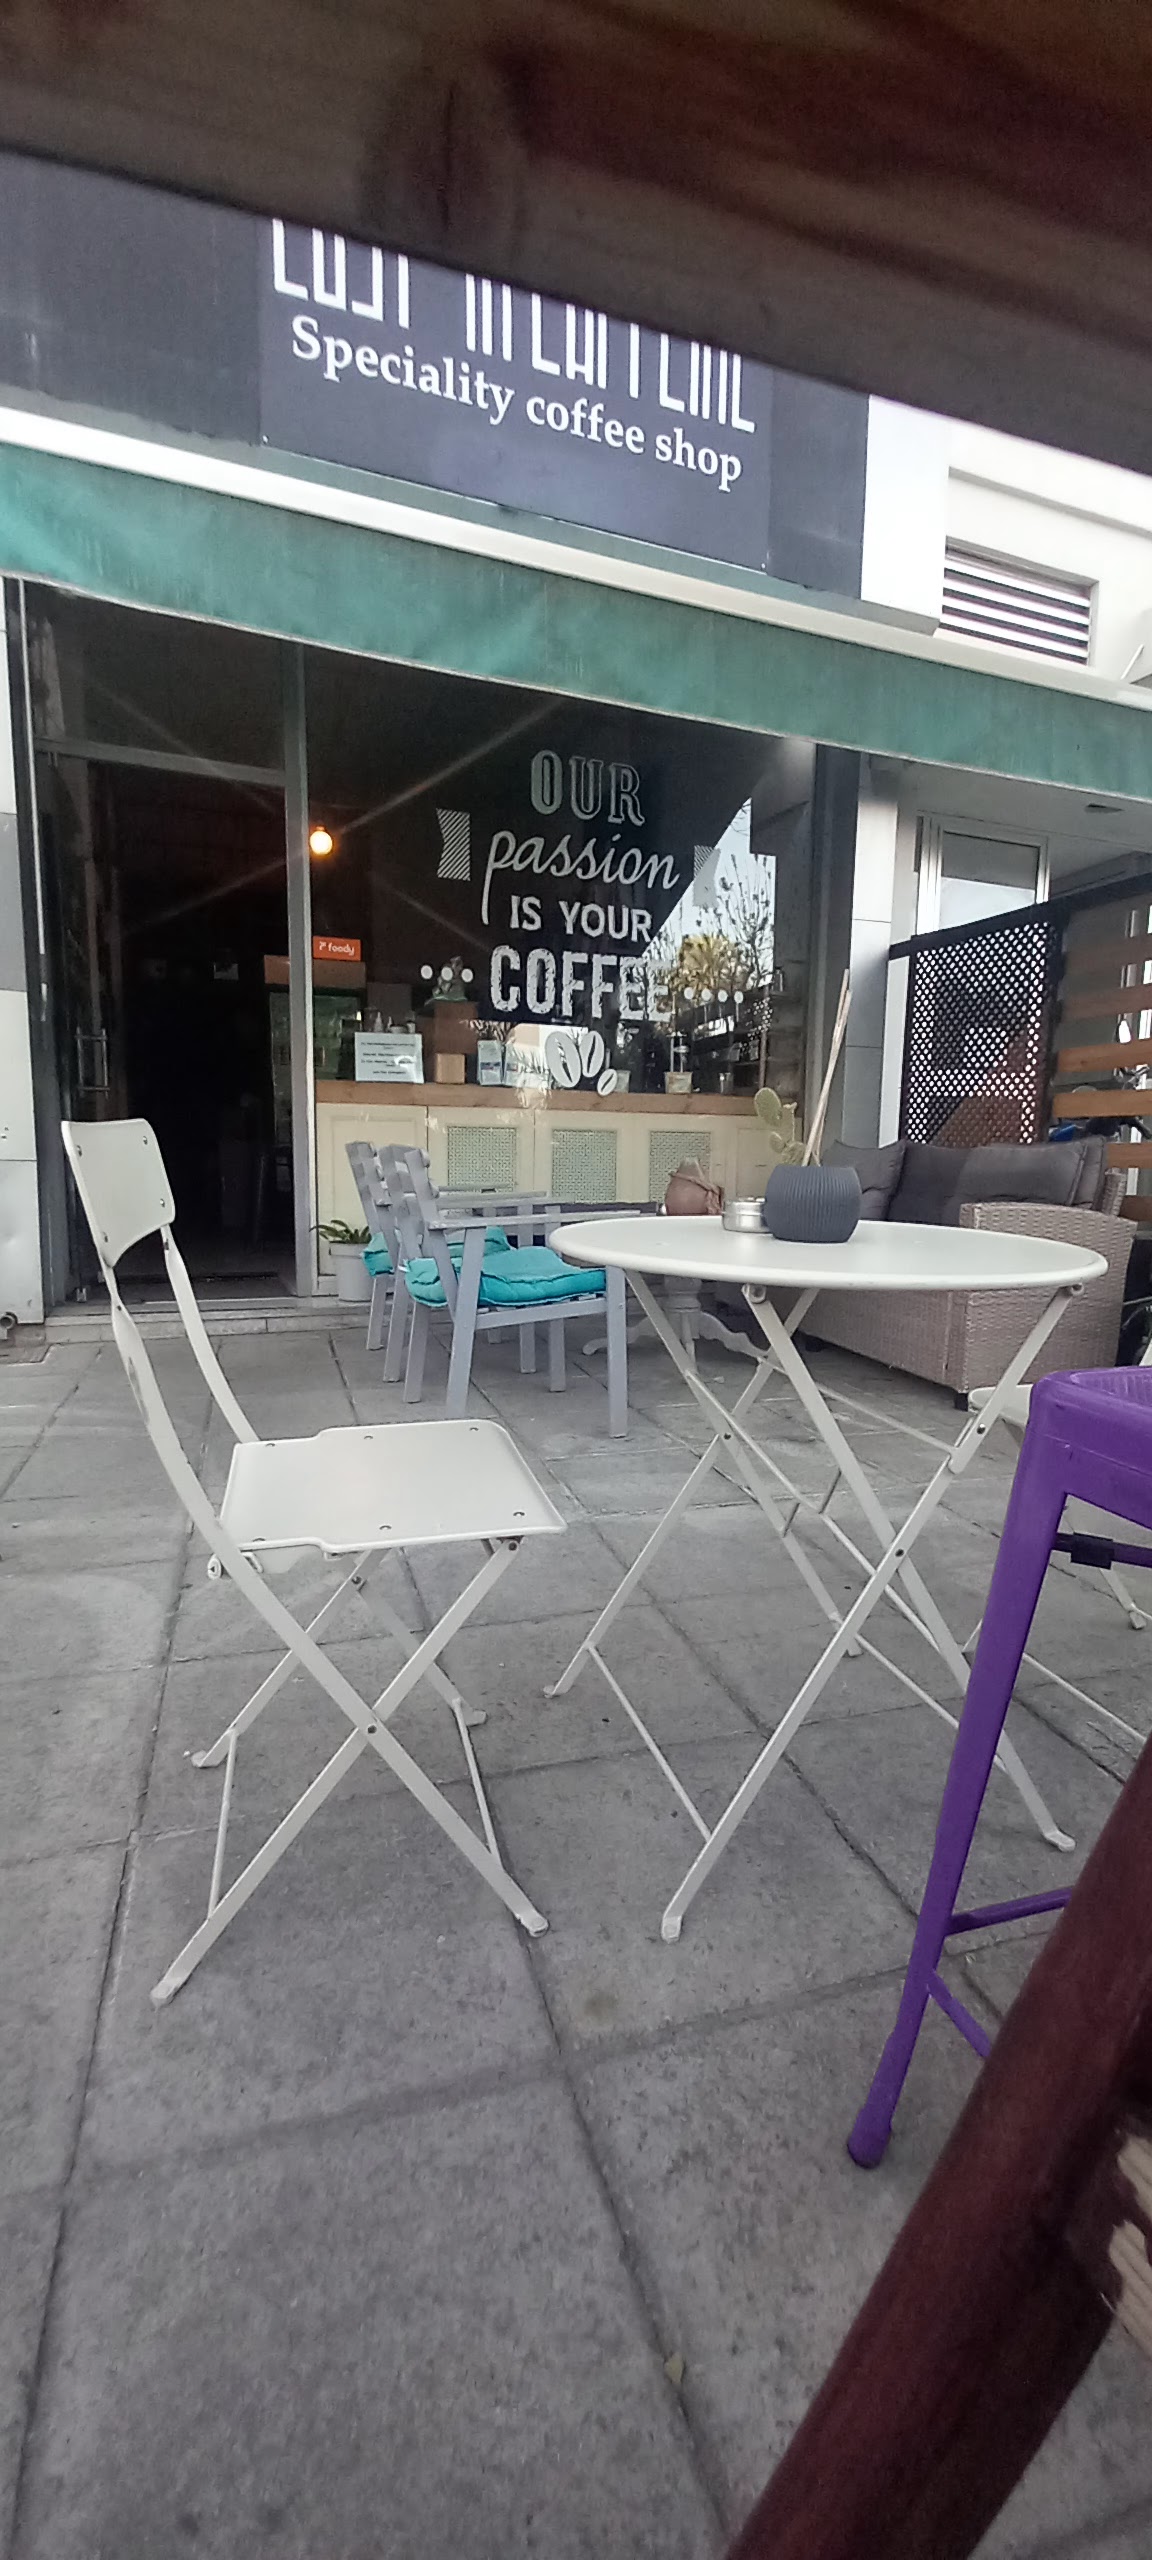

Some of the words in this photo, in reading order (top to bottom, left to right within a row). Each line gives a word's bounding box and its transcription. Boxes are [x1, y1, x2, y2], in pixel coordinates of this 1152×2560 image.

[292, 315, 515, 425] Speciality
[525, 395, 645, 454] coffee
[655, 428, 742, 492] shop
[530, 750, 646, 827] OUR
[480, 830, 681, 926] passion
[328, 942, 355, 956] foody
[509, 895, 542, 931] IS
[558, 903, 653, 943] YOUR
[490, 945, 673, 1023] COFFEE
